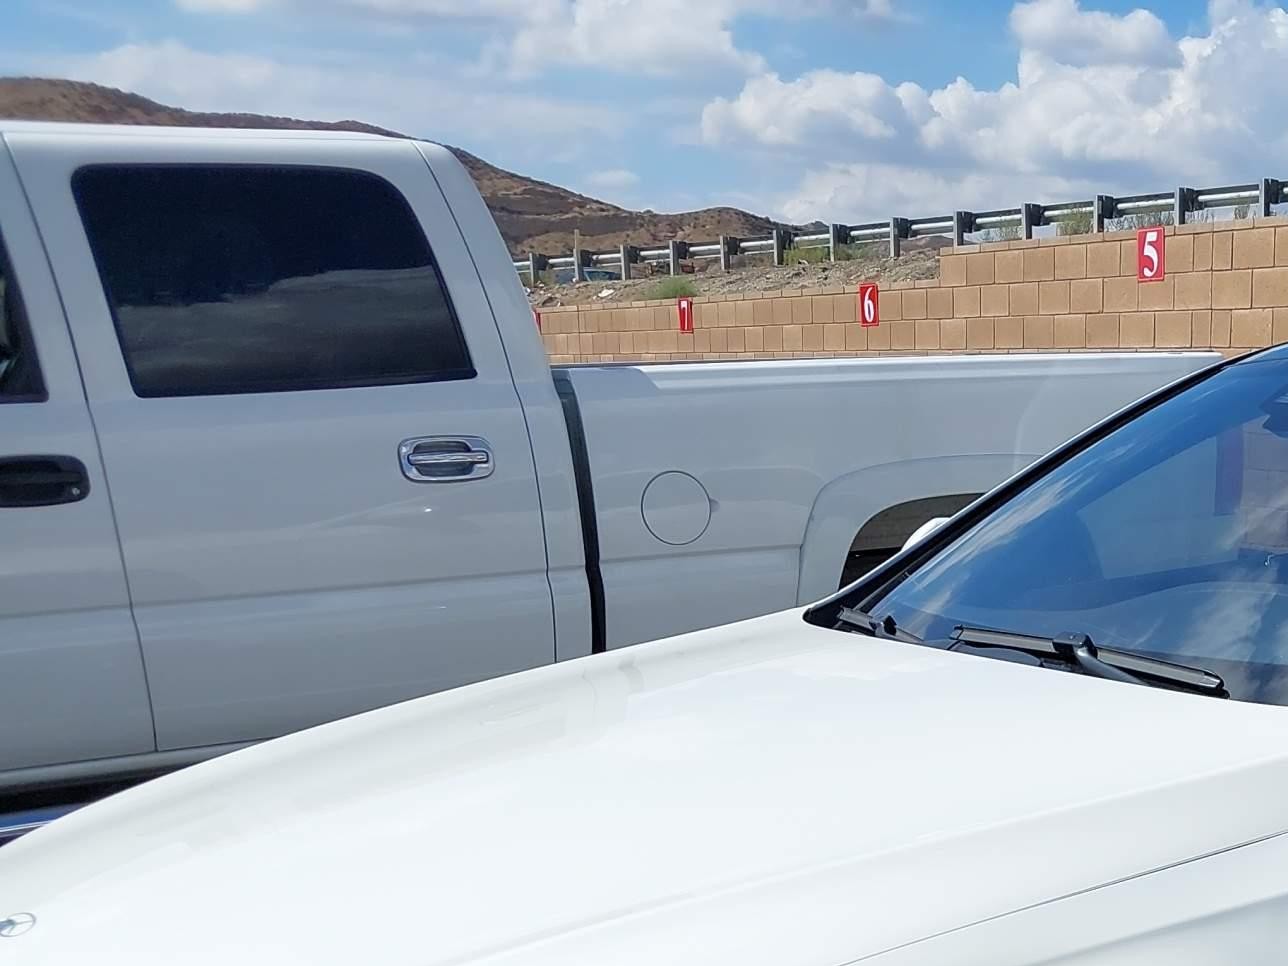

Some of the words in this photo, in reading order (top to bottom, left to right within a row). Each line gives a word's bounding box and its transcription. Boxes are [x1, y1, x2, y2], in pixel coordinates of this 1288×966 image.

[1143, 231, 1159, 277] 5
[680, 300, 688, 331] 7
[863, 287, 875, 323] 6
